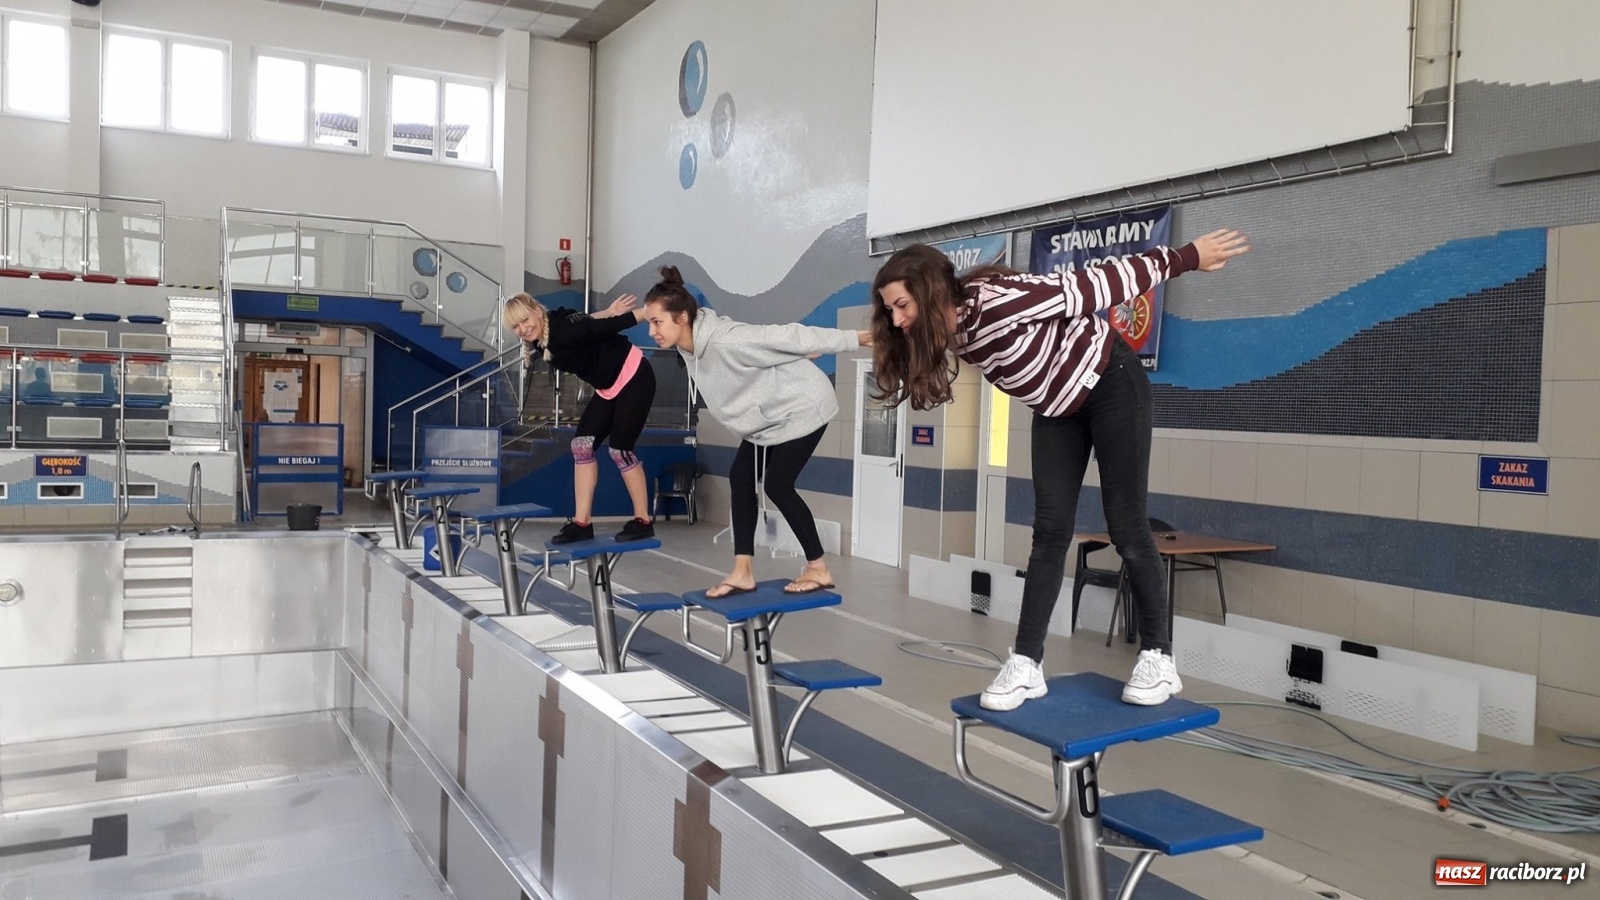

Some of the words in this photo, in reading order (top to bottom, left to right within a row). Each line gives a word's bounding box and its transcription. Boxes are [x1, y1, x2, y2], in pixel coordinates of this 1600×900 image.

[1050, 219, 1155, 254] STAWIAMY
[278, 457, 290, 465] NIE
[291, 457, 316, 465] BIEGAJ
[1498, 462, 1529, 474] ZAKAZ
[51, 467, 64, 476] 1,8
[1490, 475, 1536, 488] SKAKANIA
[392, 487, 399, 503] 1
[435, 505, 446, 524] 2
[500, 530, 511, 552] 3
[594, 564, 607, 592] 4
[753, 627, 769, 665] 5
[1076, 760, 1099, 819] 6
